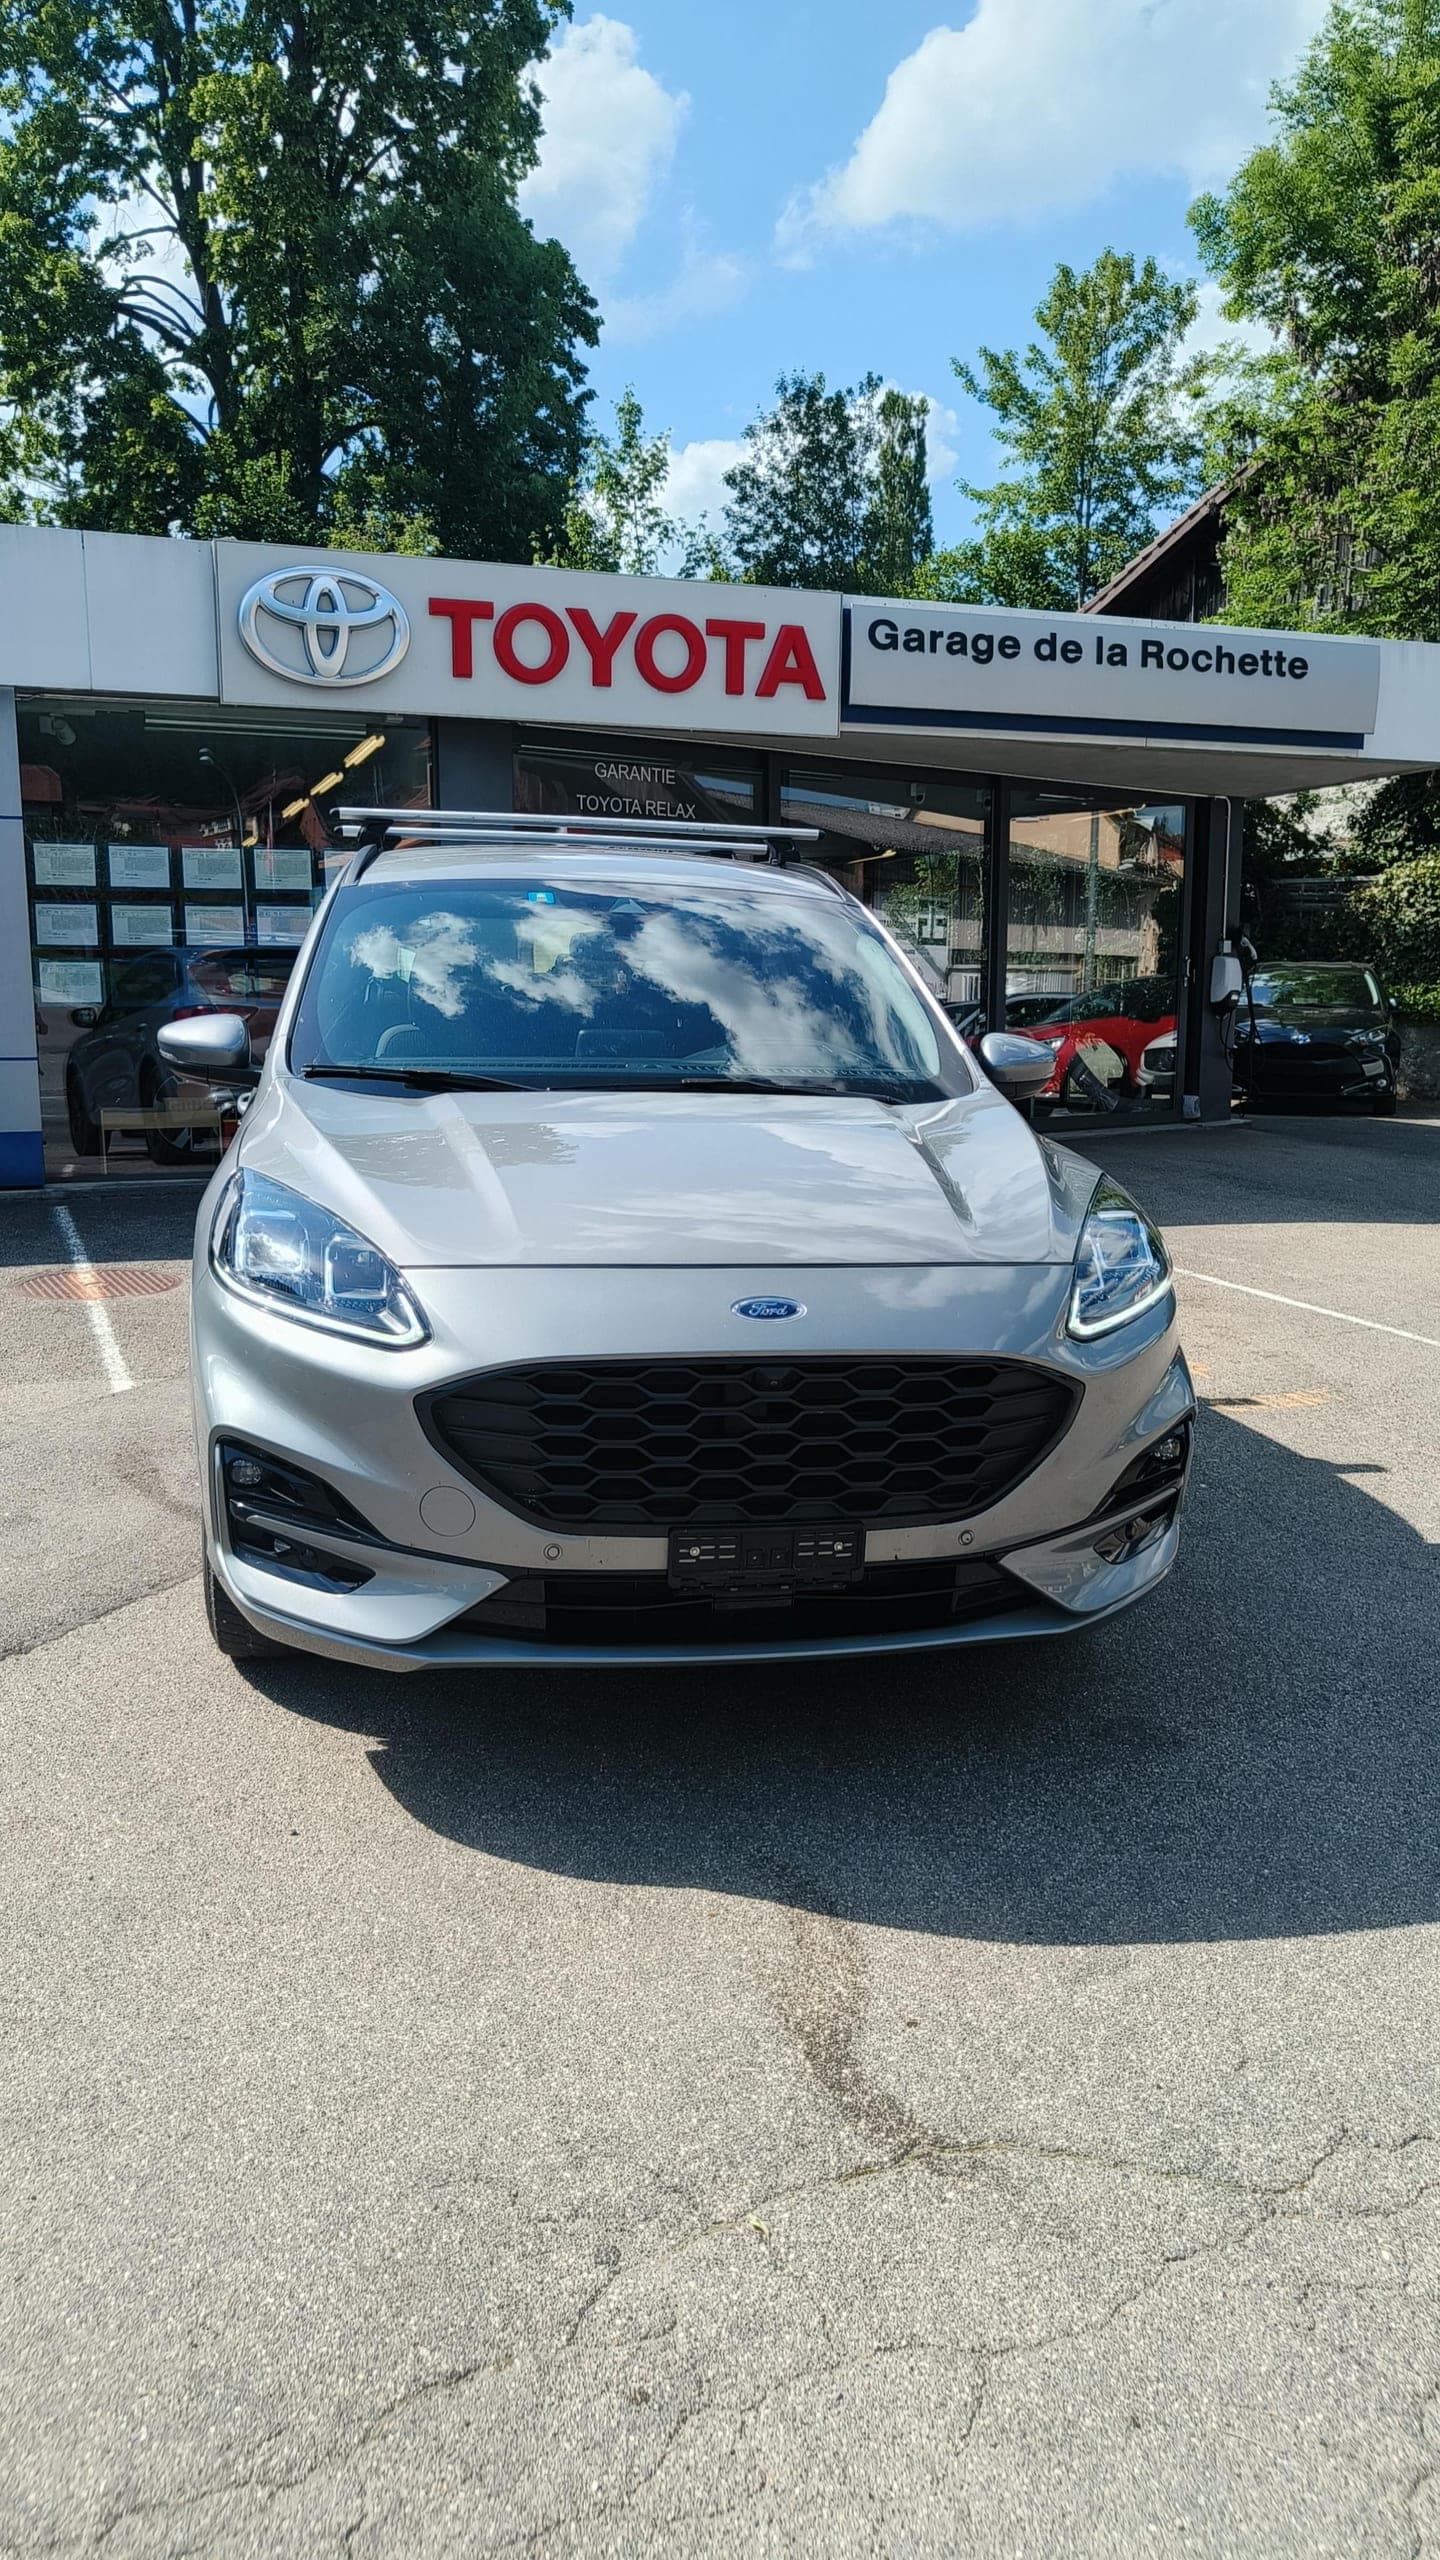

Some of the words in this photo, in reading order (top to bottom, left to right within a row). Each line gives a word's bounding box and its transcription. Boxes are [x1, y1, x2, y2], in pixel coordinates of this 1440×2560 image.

[428, 597, 826, 701] TOYOTA
[867, 618, 1020, 665] Garage
[1033, 632, 1082, 664] de
[1095, 634, 1128, 668] la
[1141, 639, 1309, 681] Rochette
[594, 761, 676, 785] GARANTIE
[576, 794, 642, 815] TOYOTA
[645, 801, 696, 819] RELAX
[748, 1302, 788, 1317] Ford
